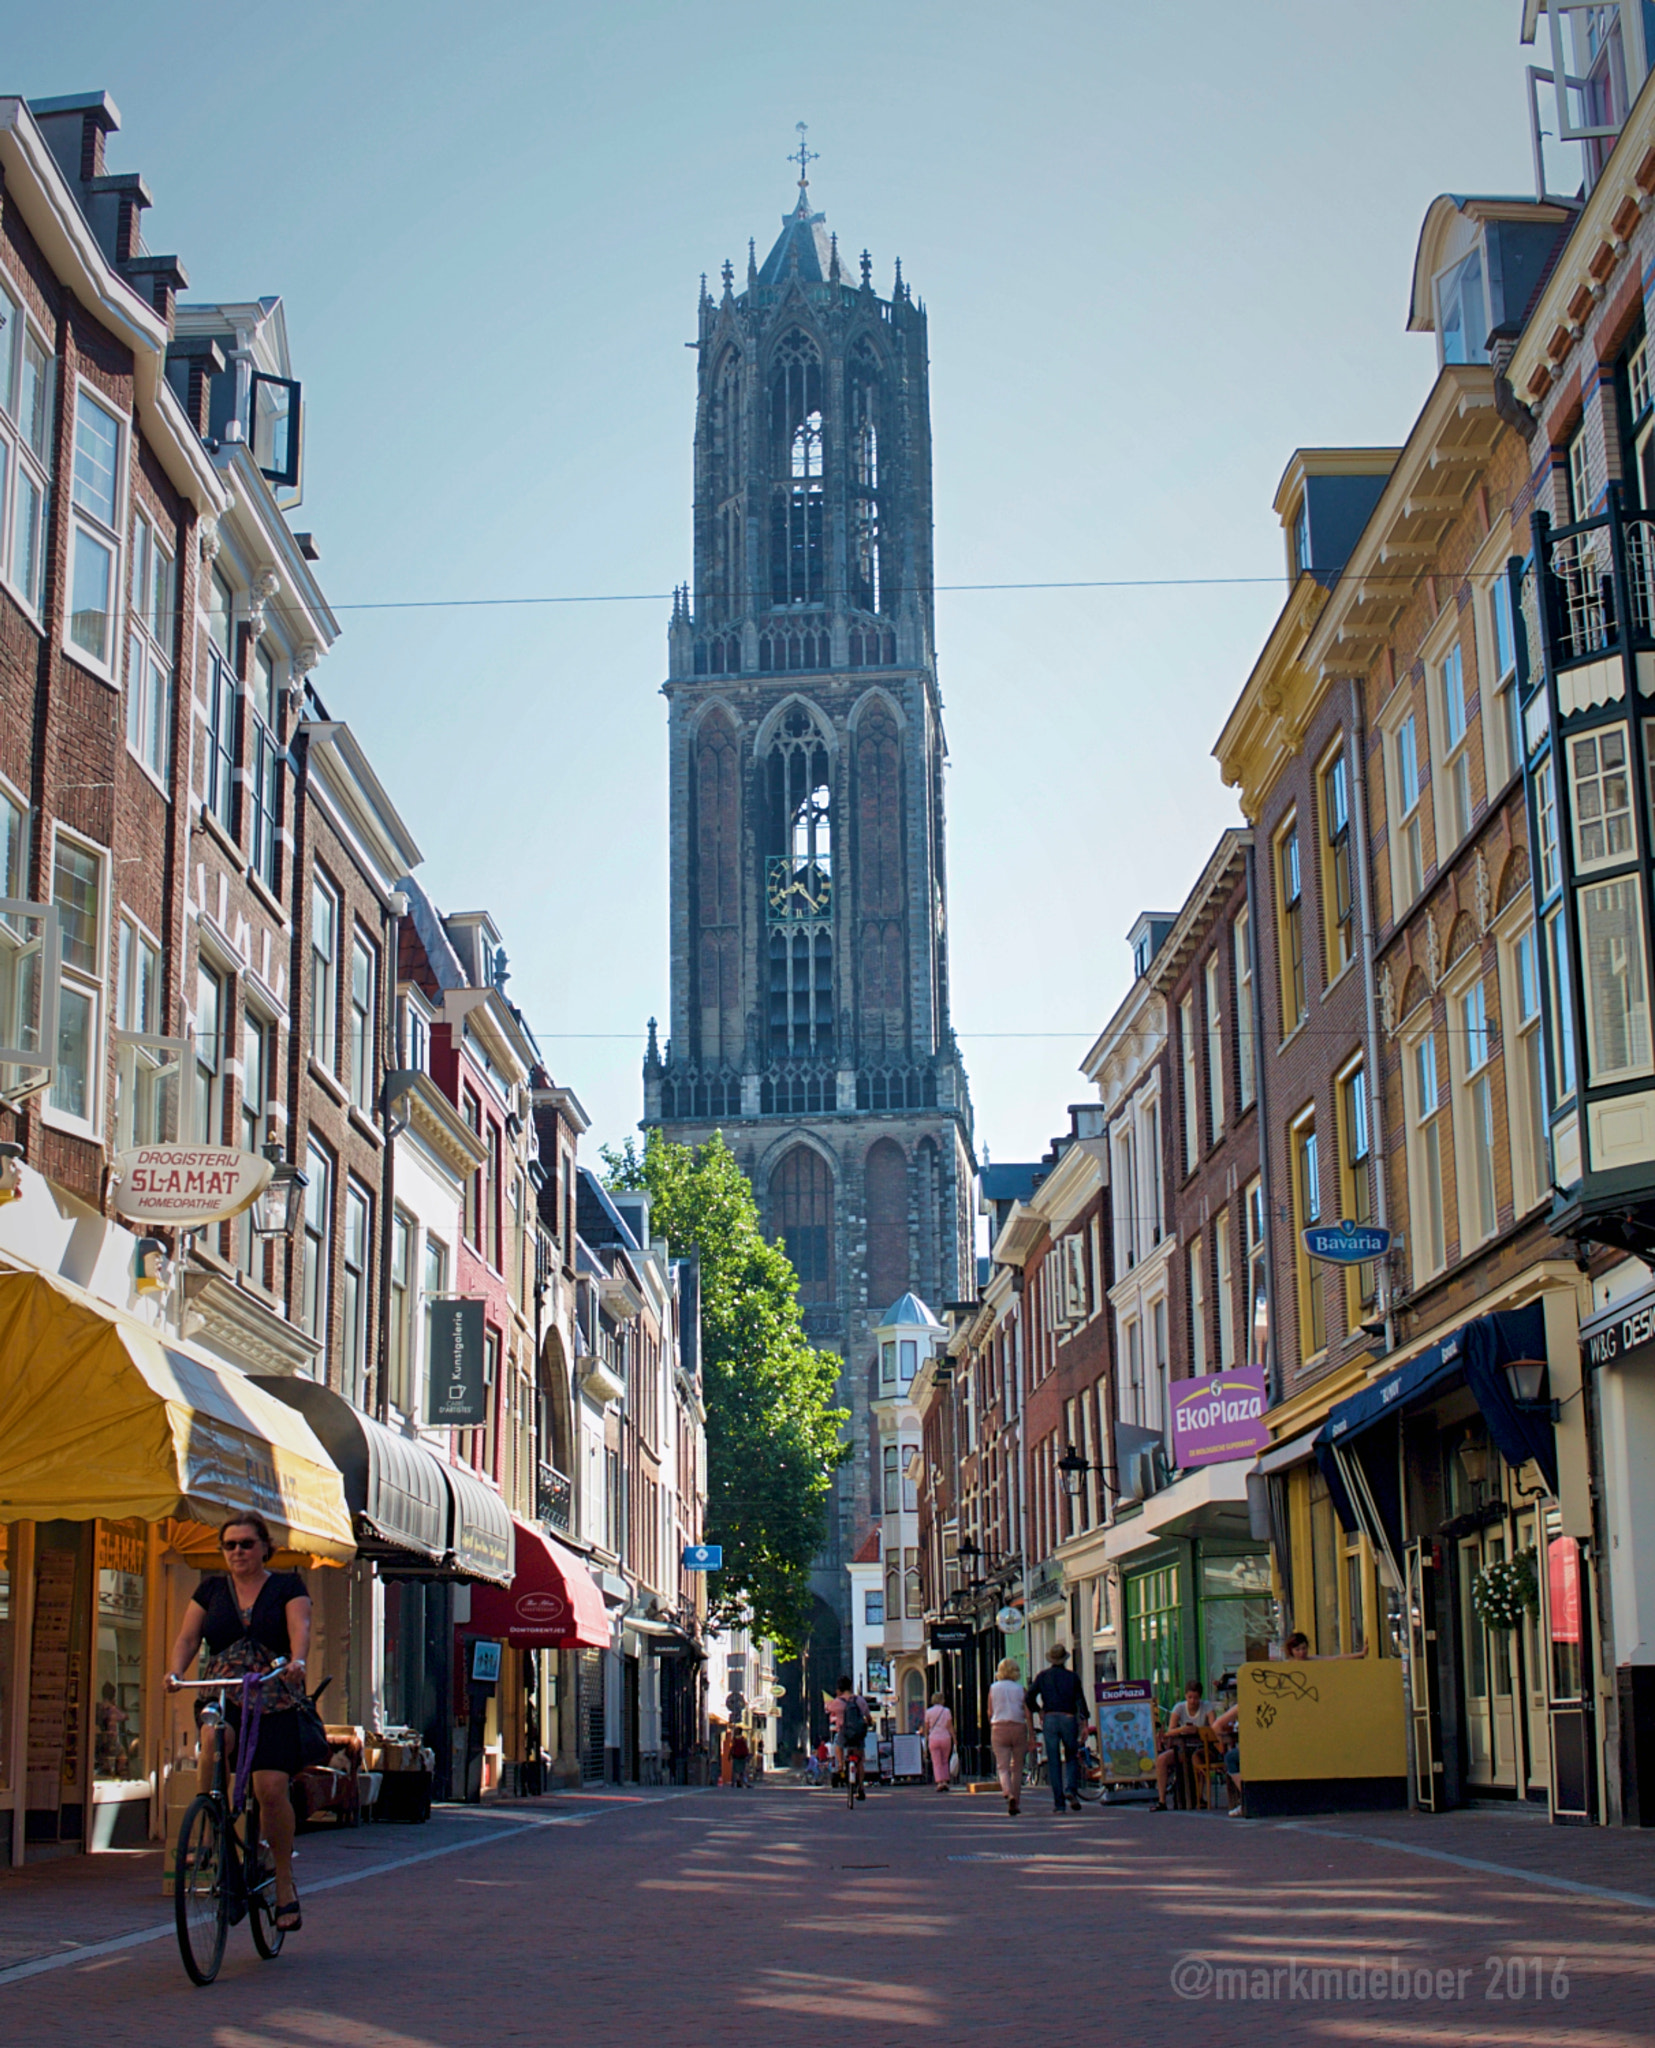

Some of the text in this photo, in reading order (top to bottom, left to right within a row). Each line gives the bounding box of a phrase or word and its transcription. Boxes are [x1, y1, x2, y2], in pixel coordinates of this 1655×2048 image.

[138, 1151, 240, 1167] DROGISTERIJ
[131, 1168, 240, 1194] SLAMAT
[138, 1197, 221, 1210] HOMEOPATHIE
[1316, 1235, 1381, 1252] Bavaria
[452, 1311, 464, 1381] Kunstgalerie
[1590, 1306, 1655, 1365] W&G DESI
[1176, 1397, 1262, 1432] EkoPlaza
